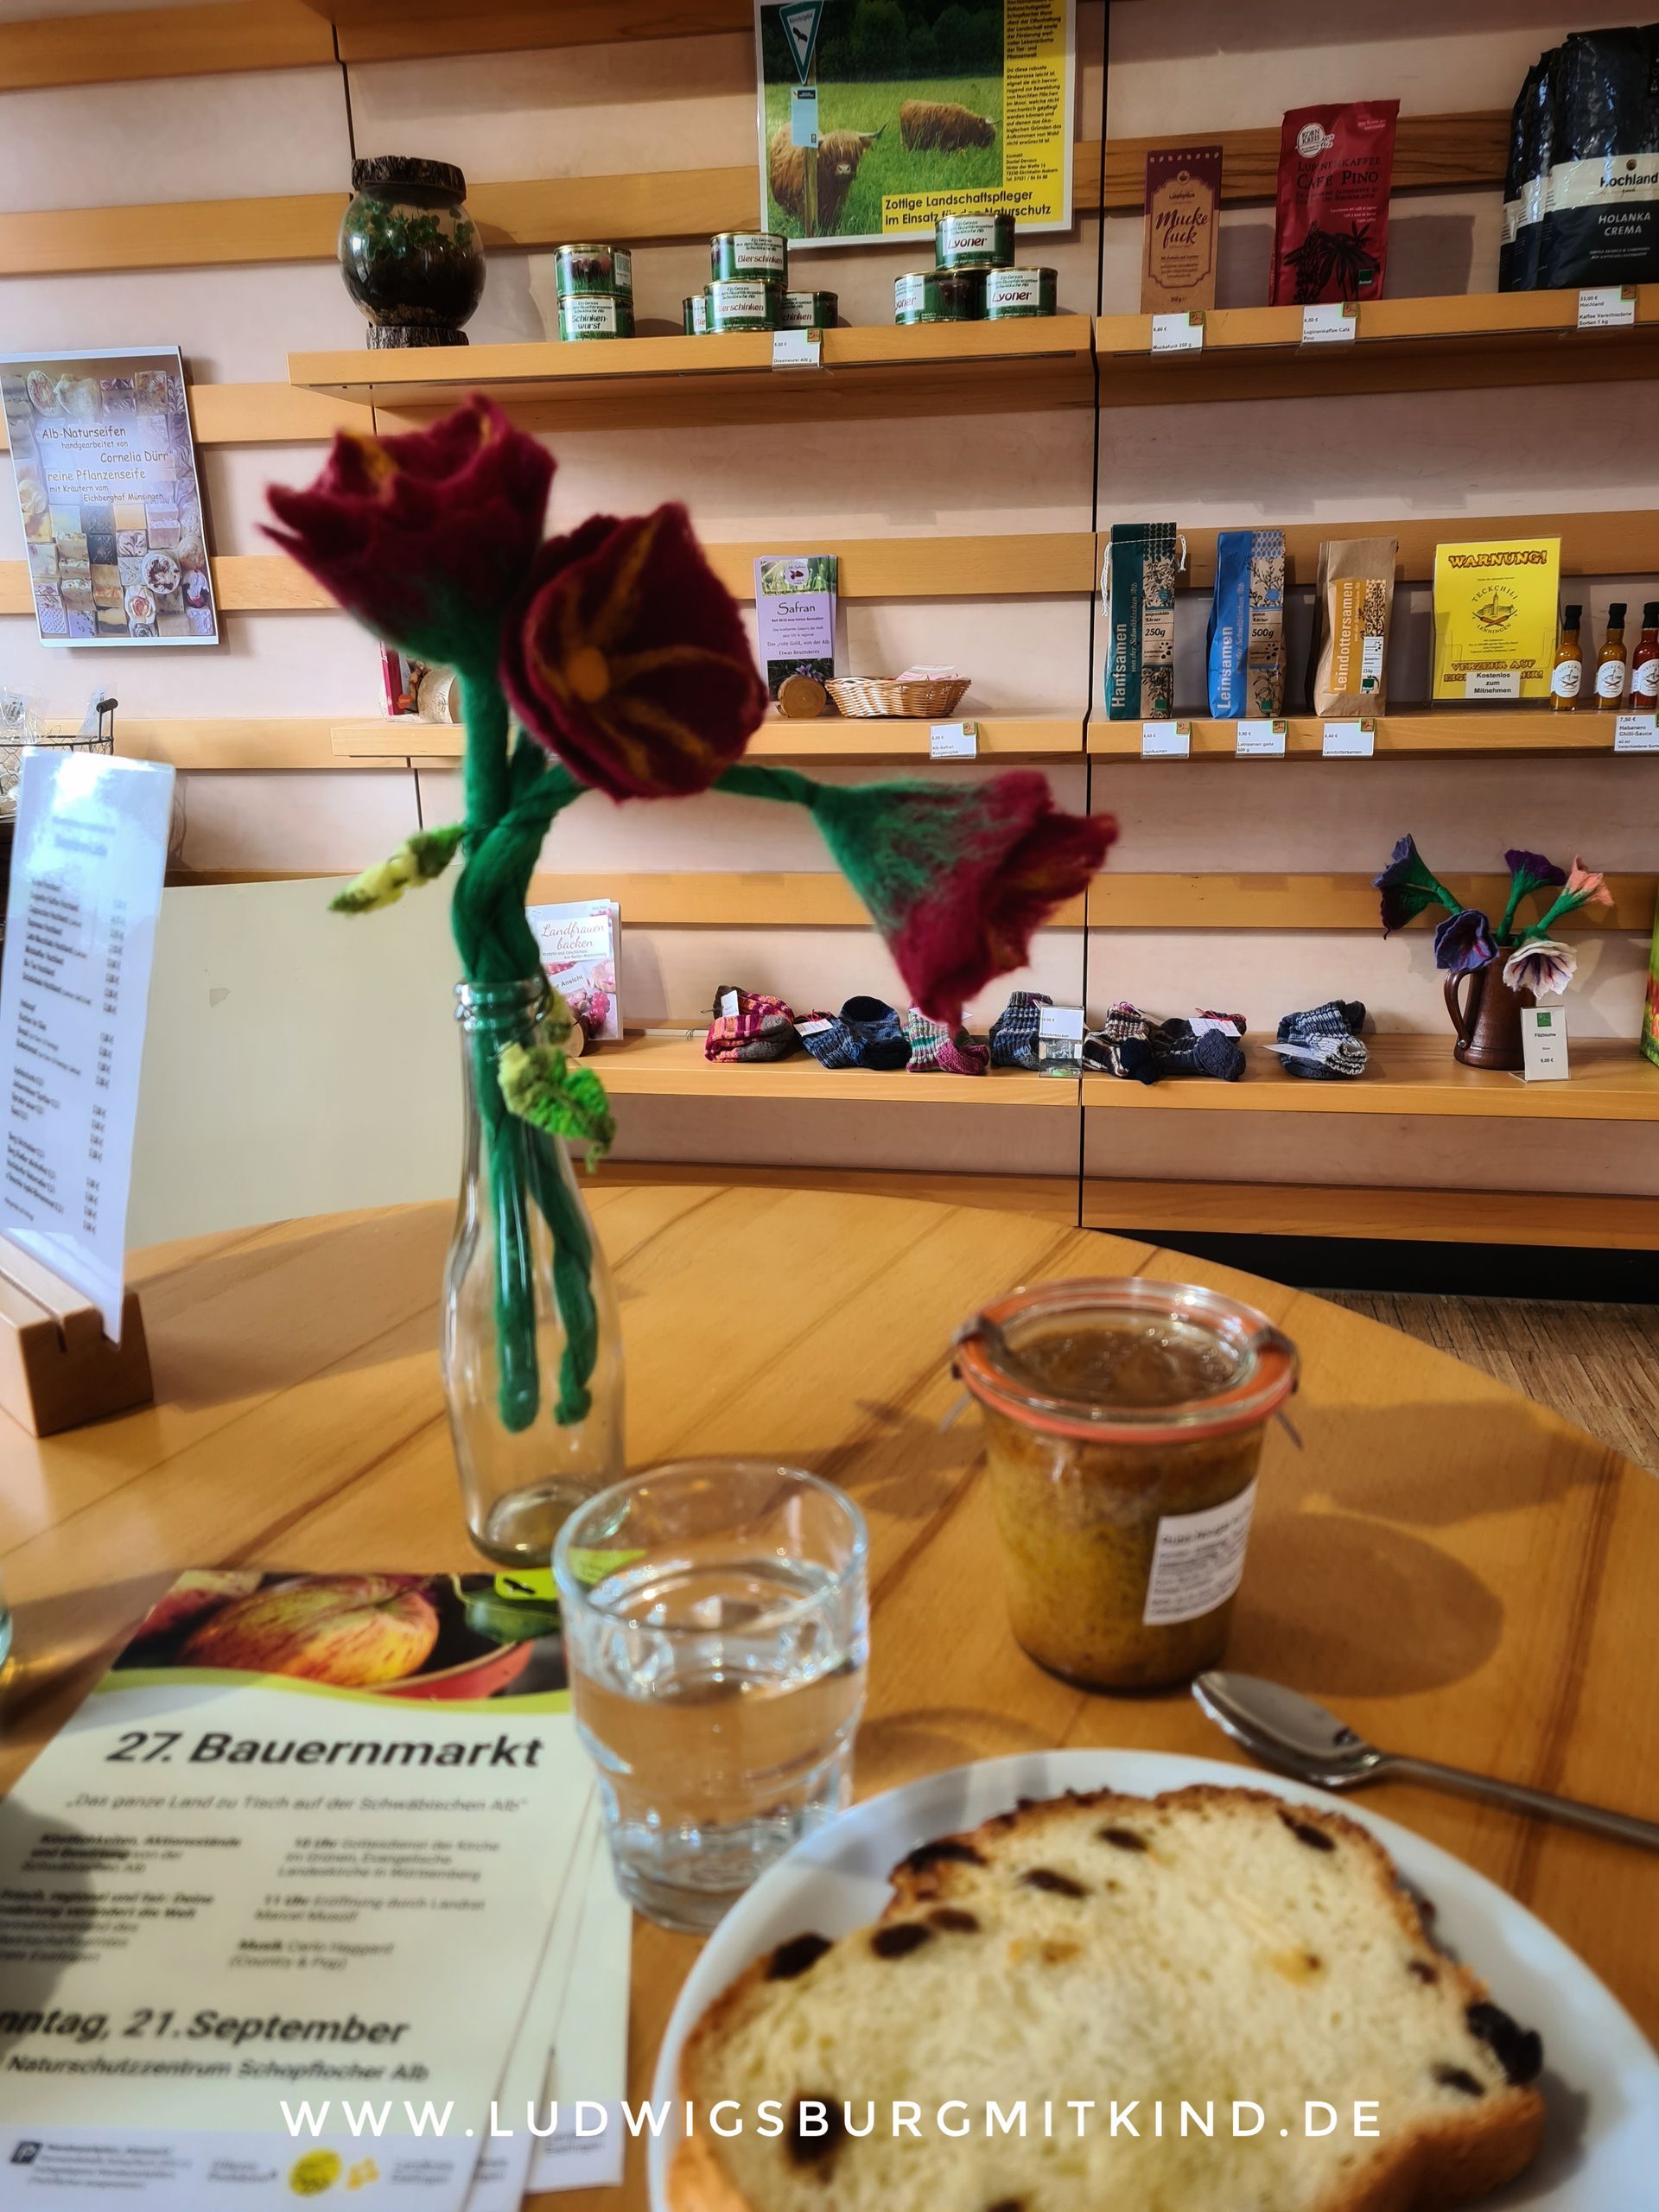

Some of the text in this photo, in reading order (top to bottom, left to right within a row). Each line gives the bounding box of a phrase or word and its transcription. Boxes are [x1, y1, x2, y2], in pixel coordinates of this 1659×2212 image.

[926, 190, 1033, 207] Landschaftspfleger
[903, 212, 938, 224] Einsatz
[1155, 207, 1207, 230] Mucke
[1598, 212, 1651, 225] HOLANKA
[1163, 226, 1197, 249] fuck
[1604, 225, 1643, 236] CREMA
[42, 426, 126, 439] Alb-Naturseifen
[61, 441, 114, 450] handgearbeitet
[100, 451, 142, 463] Cornelia
[48, 467, 146, 481] reine Pflanzenseife
[83, 492, 163, 503] Eichberghof Münsingen
[1448, 550, 1548, 569] WARNUNG!
[1471, 585, 1518, 602] TECKCHILI
[777, 601, 816, 615] Safran
[1145, 628, 1166, 638] 250g
[1251, 628, 1274, 639] 500g
[1334, 582, 1353, 692] Leindottersamen
[1111, 623, 1127, 708] Hanfsamen
[1217, 626, 1233, 709] Leinsamen
[1510, 659, 1535, 669] AUF
[541, 921, 604, 938] Landfrauen
[556, 936, 594, 950] backen
[561, 975, 584, 988] Ansicht
[105, 1732, 544, 1769] 27. Bauernmarkt
[111, 1797, 165, 1811] ganze
[169, 1796, 215, 1808] Land
[217, 1799, 238, 1809] zu
[244, 1795, 289, 1809] Tisch
[293, 1796, 323, 1809] auf
[327, 1796, 353, 1809] der
[359, 1797, 486, 1811] Schwäbischen
[0, 2009, 109, 2043] nntag,
[5, 2055, 429, 2082] Naturschutzzentrum Schopflocher Alb
